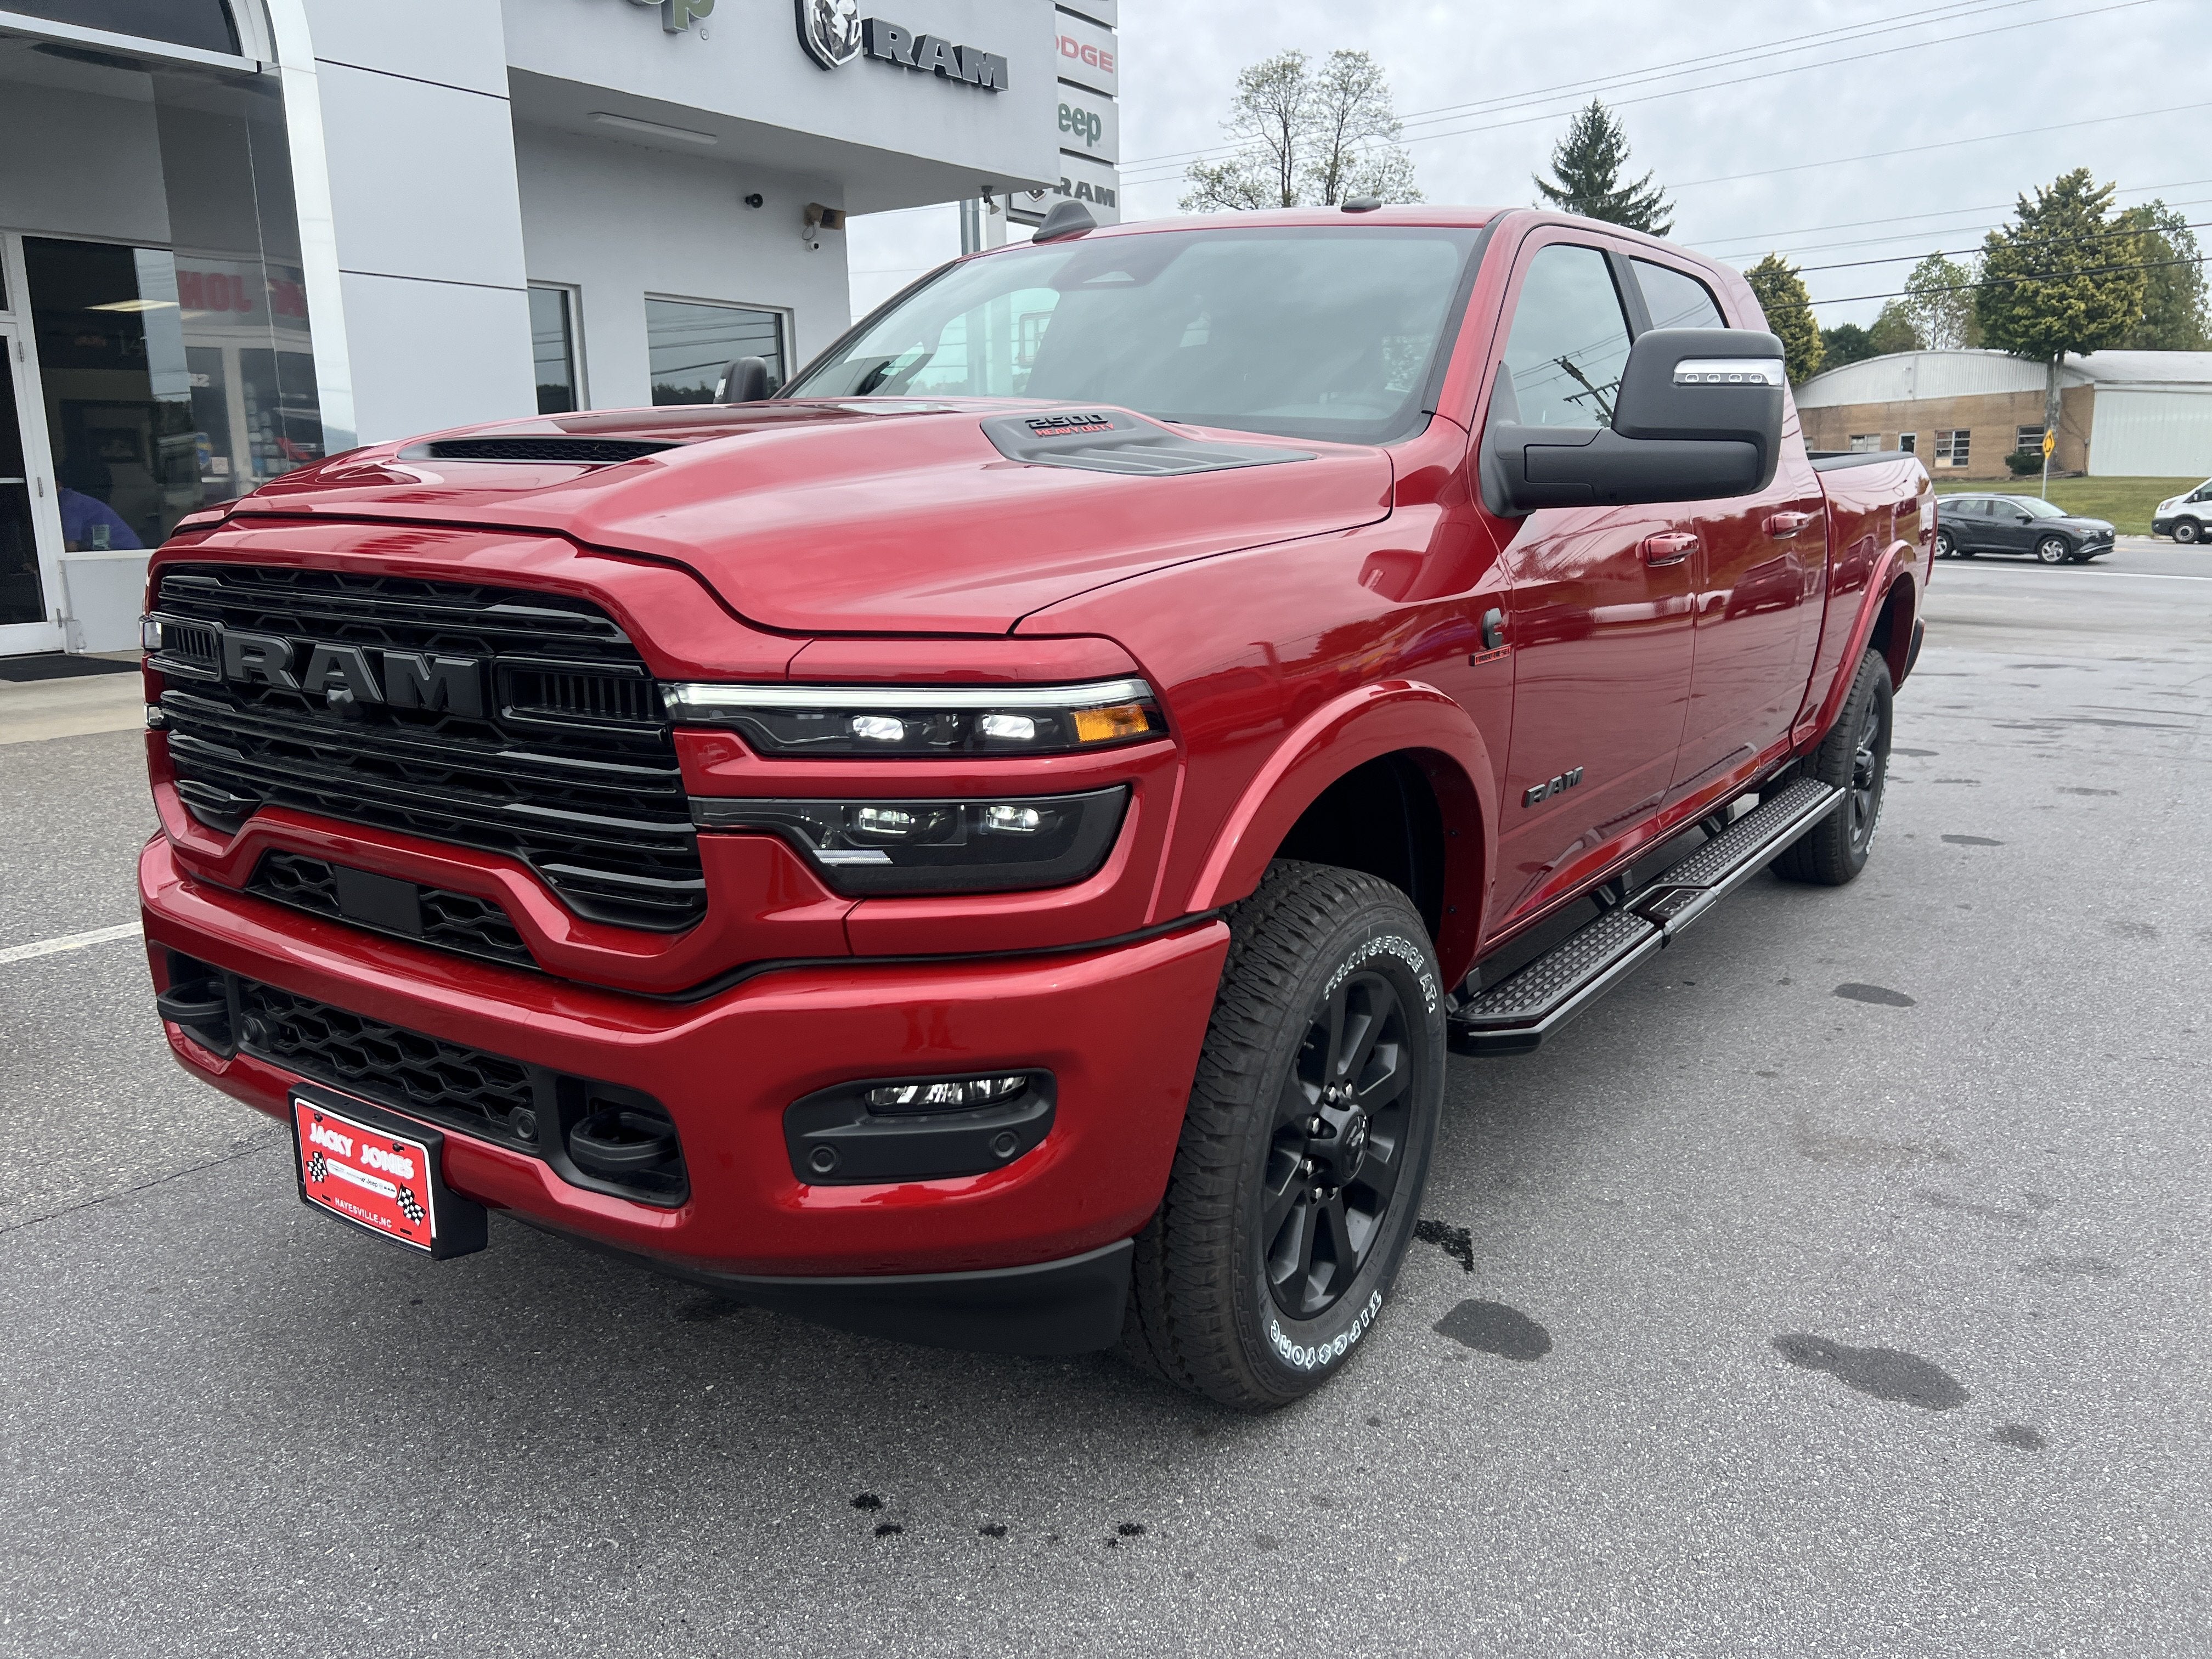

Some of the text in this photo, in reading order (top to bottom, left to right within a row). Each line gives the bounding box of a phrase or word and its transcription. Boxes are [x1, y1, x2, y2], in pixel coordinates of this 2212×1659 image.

[862, 17, 1008, 92] RAM
[1056, 35, 1113, 74] DGE
[1058, 103, 1101, 147] eep
[1053, 177, 1115, 208] RAM
[1025, 415, 1108, 429] 2500
[1035, 424, 1115, 437] HEAVY DUTY
[222, 631, 481, 716] RAM
[1522, 766, 1583, 808] RAM
[1323, 935, 1425, 1001] TRANSFORCE
[309, 1122, 414, 1180] JACKY JONES
[1270, 1290, 1382, 1370] Firestone
